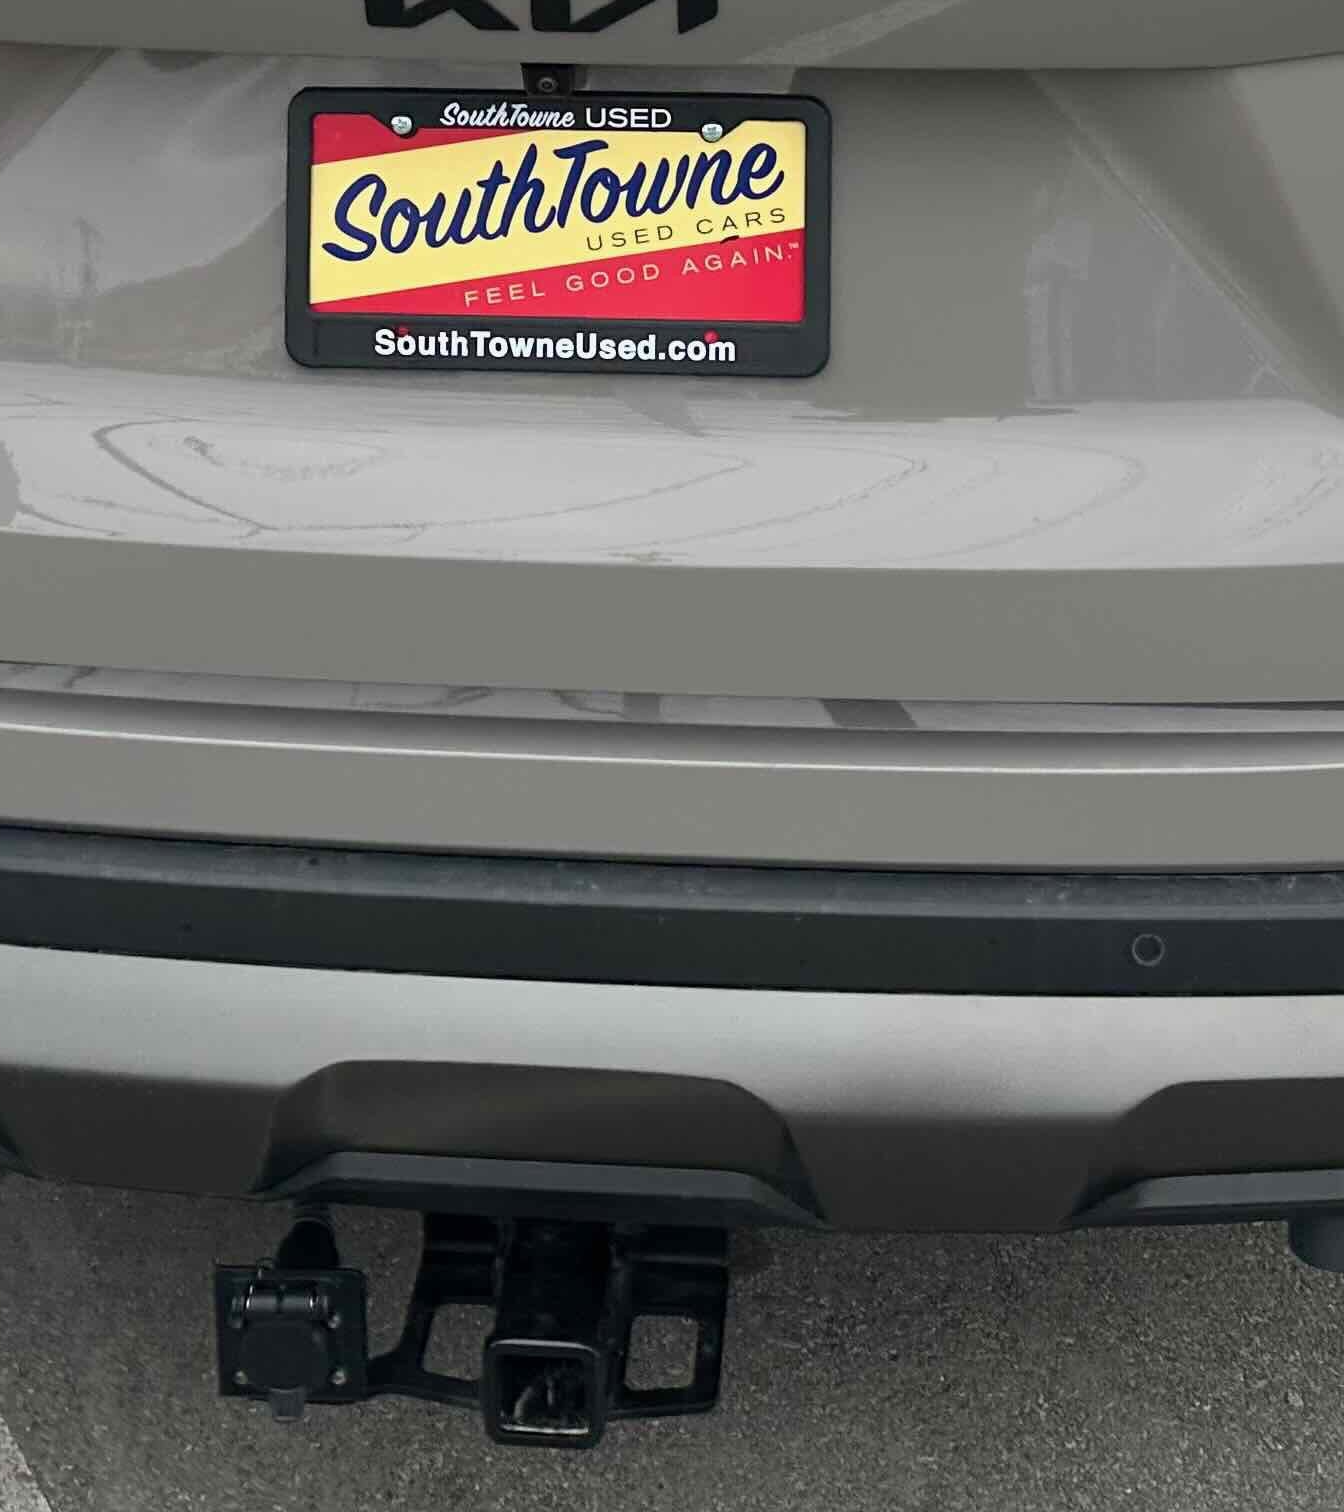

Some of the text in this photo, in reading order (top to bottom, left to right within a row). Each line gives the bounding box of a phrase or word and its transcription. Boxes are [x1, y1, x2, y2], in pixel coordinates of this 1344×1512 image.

[439, 103, 672, 129] SouthTowne USED
[323, 140, 784, 262] SouthTowne
[586, 208, 787, 251] USED CARS
[464, 285, 545, 307] FEEL
[565, 263, 661, 292] GOOD
[374, 328, 736, 362] SouthTowneUsed.com
